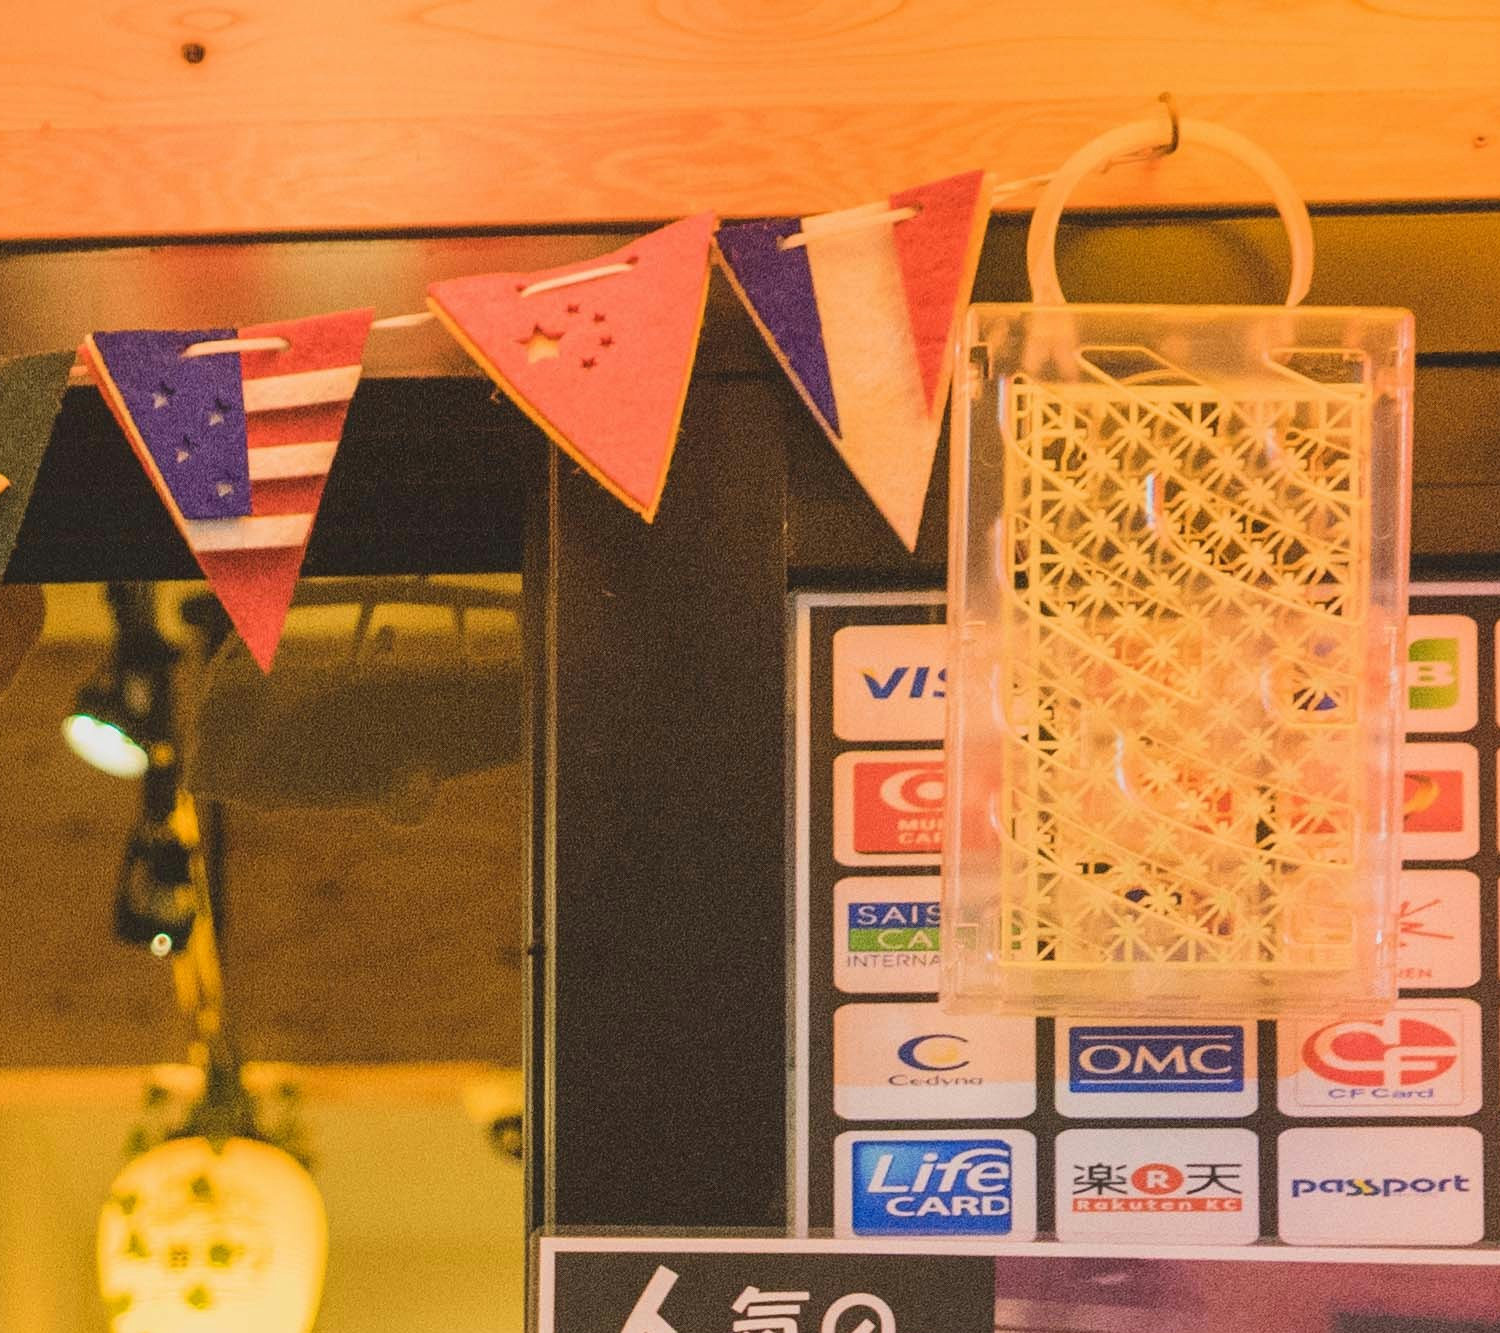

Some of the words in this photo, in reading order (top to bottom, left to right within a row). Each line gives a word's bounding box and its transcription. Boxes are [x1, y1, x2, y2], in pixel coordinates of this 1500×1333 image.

[1077, 1042, 1234, 1077] OMC
[868, 1146, 1012, 1197] Life
[1291, 1171, 1471, 1199] passport
[884, 1195, 1012, 1219] CARD
